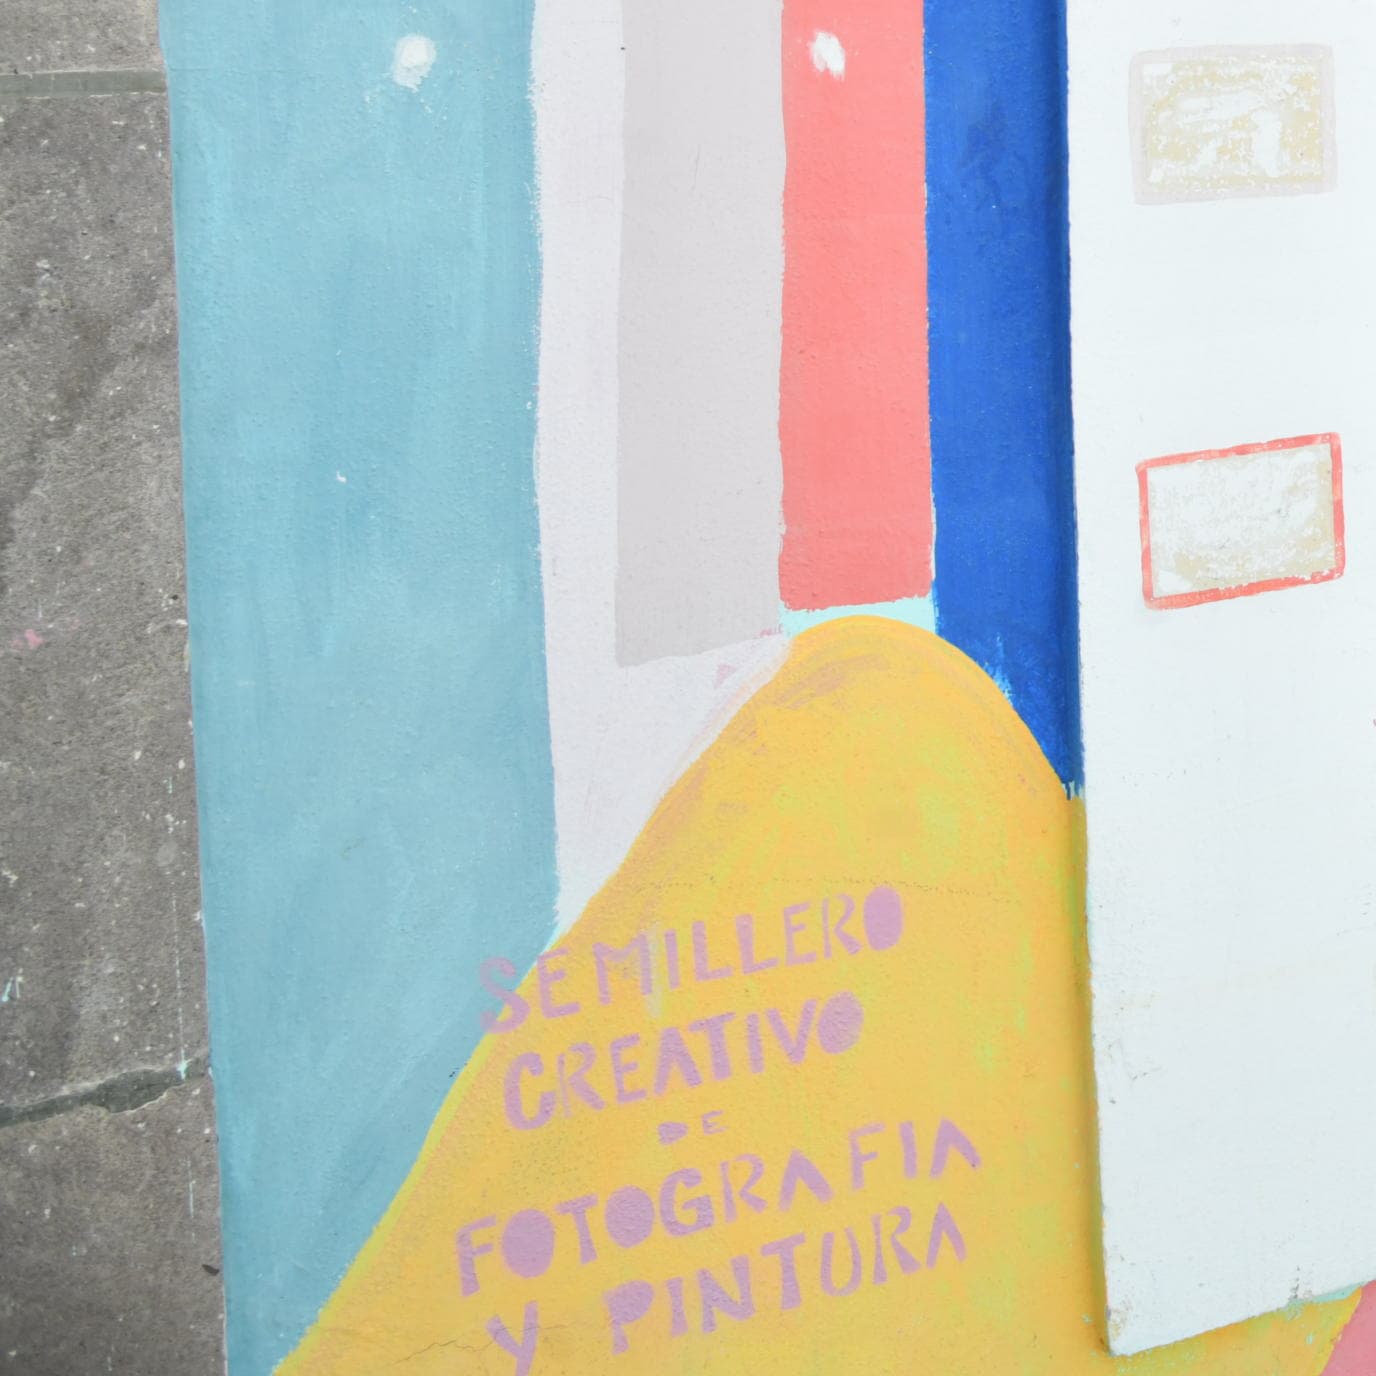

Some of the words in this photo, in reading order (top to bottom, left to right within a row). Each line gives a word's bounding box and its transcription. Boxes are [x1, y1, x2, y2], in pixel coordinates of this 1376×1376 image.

[478, 886, 902, 1034] SEMILLERO
[503, 990, 864, 1130] CREATIVO
[657, 1110, 728, 1144] DE
[455, 1118, 982, 1297] FOTOGRAFIA
[486, 1300, 539, 1376] Y
[602, 1201, 967, 1355] PINTURA
